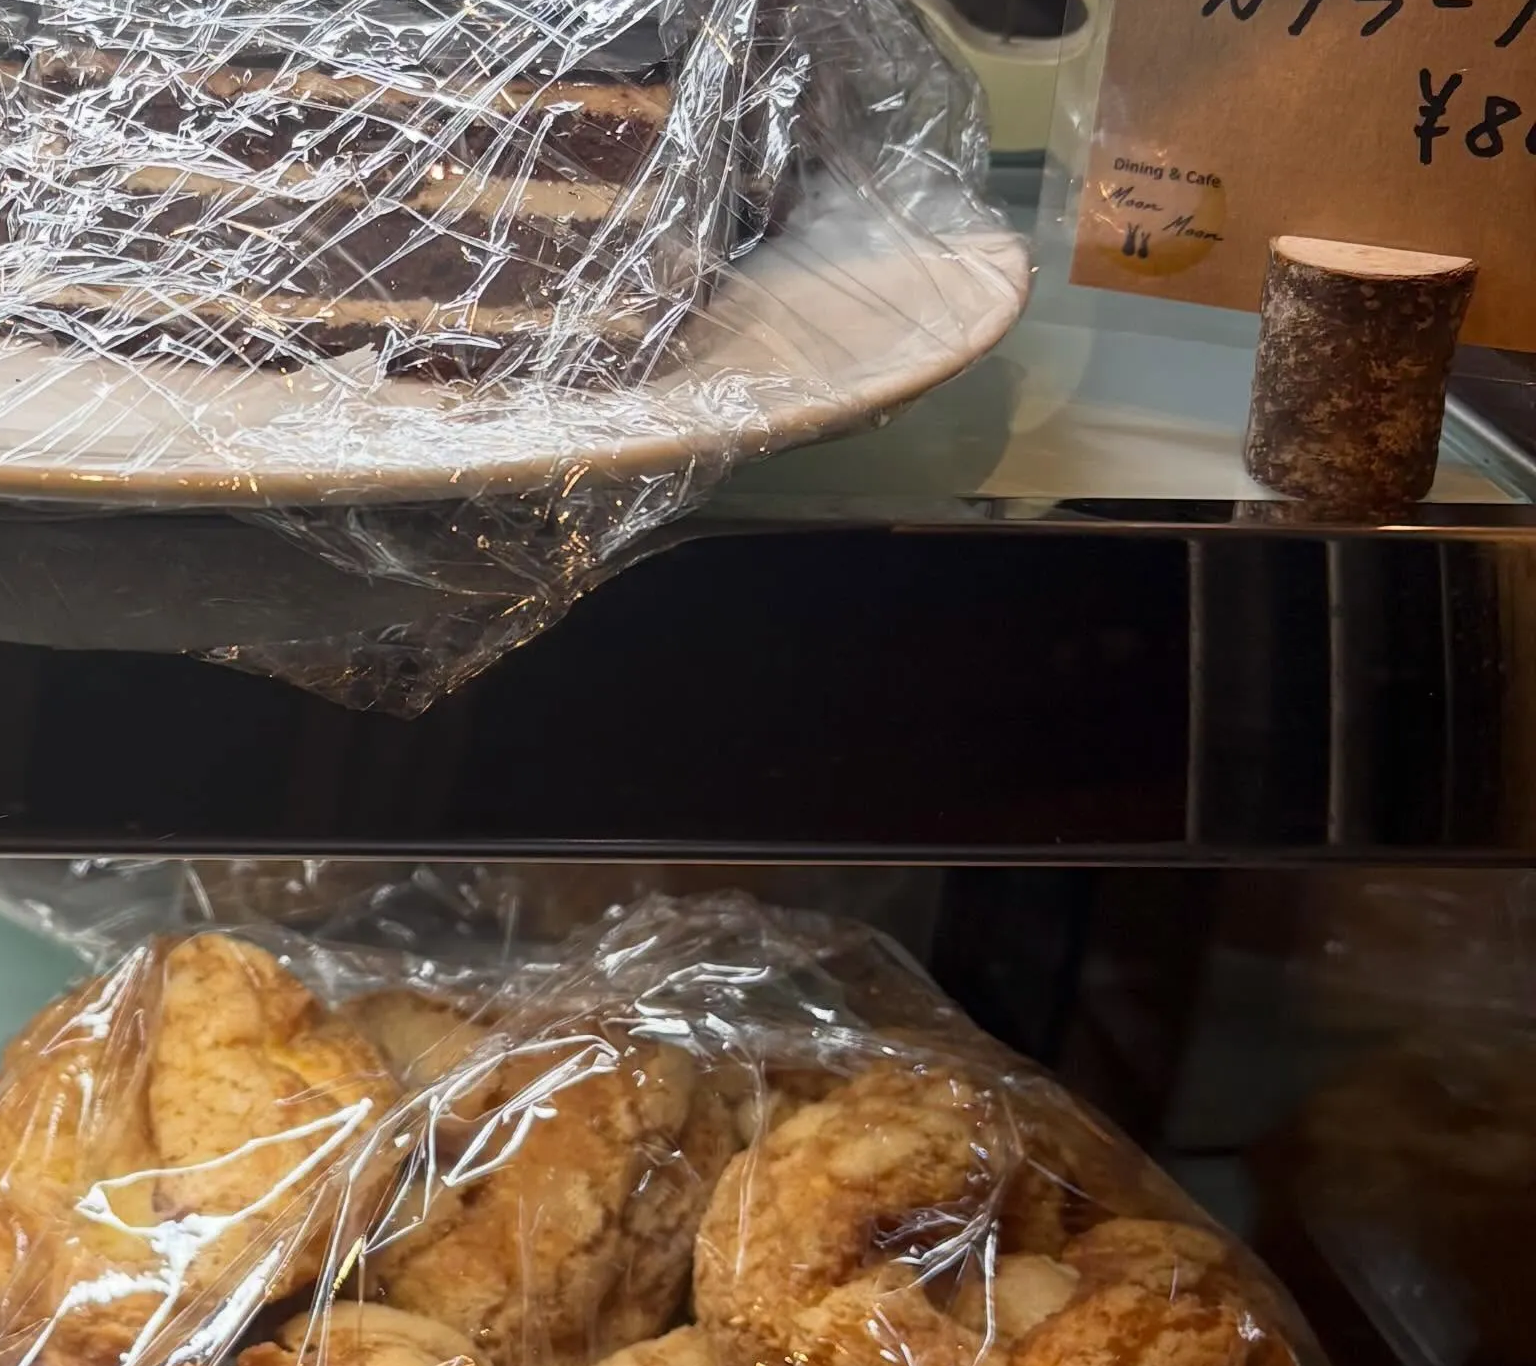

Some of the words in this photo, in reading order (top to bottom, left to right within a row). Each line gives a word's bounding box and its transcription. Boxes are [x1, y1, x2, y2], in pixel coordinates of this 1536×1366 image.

[1414, 68, 1536, 165] ¥8
[1113, 157, 1164, 180] Dining
[1168, 167, 1182, 181] &
[1186, 170, 1222, 188] Cafe
[1102, 186, 1163, 211] Moon
[1162, 215, 1224, 241] Moon
